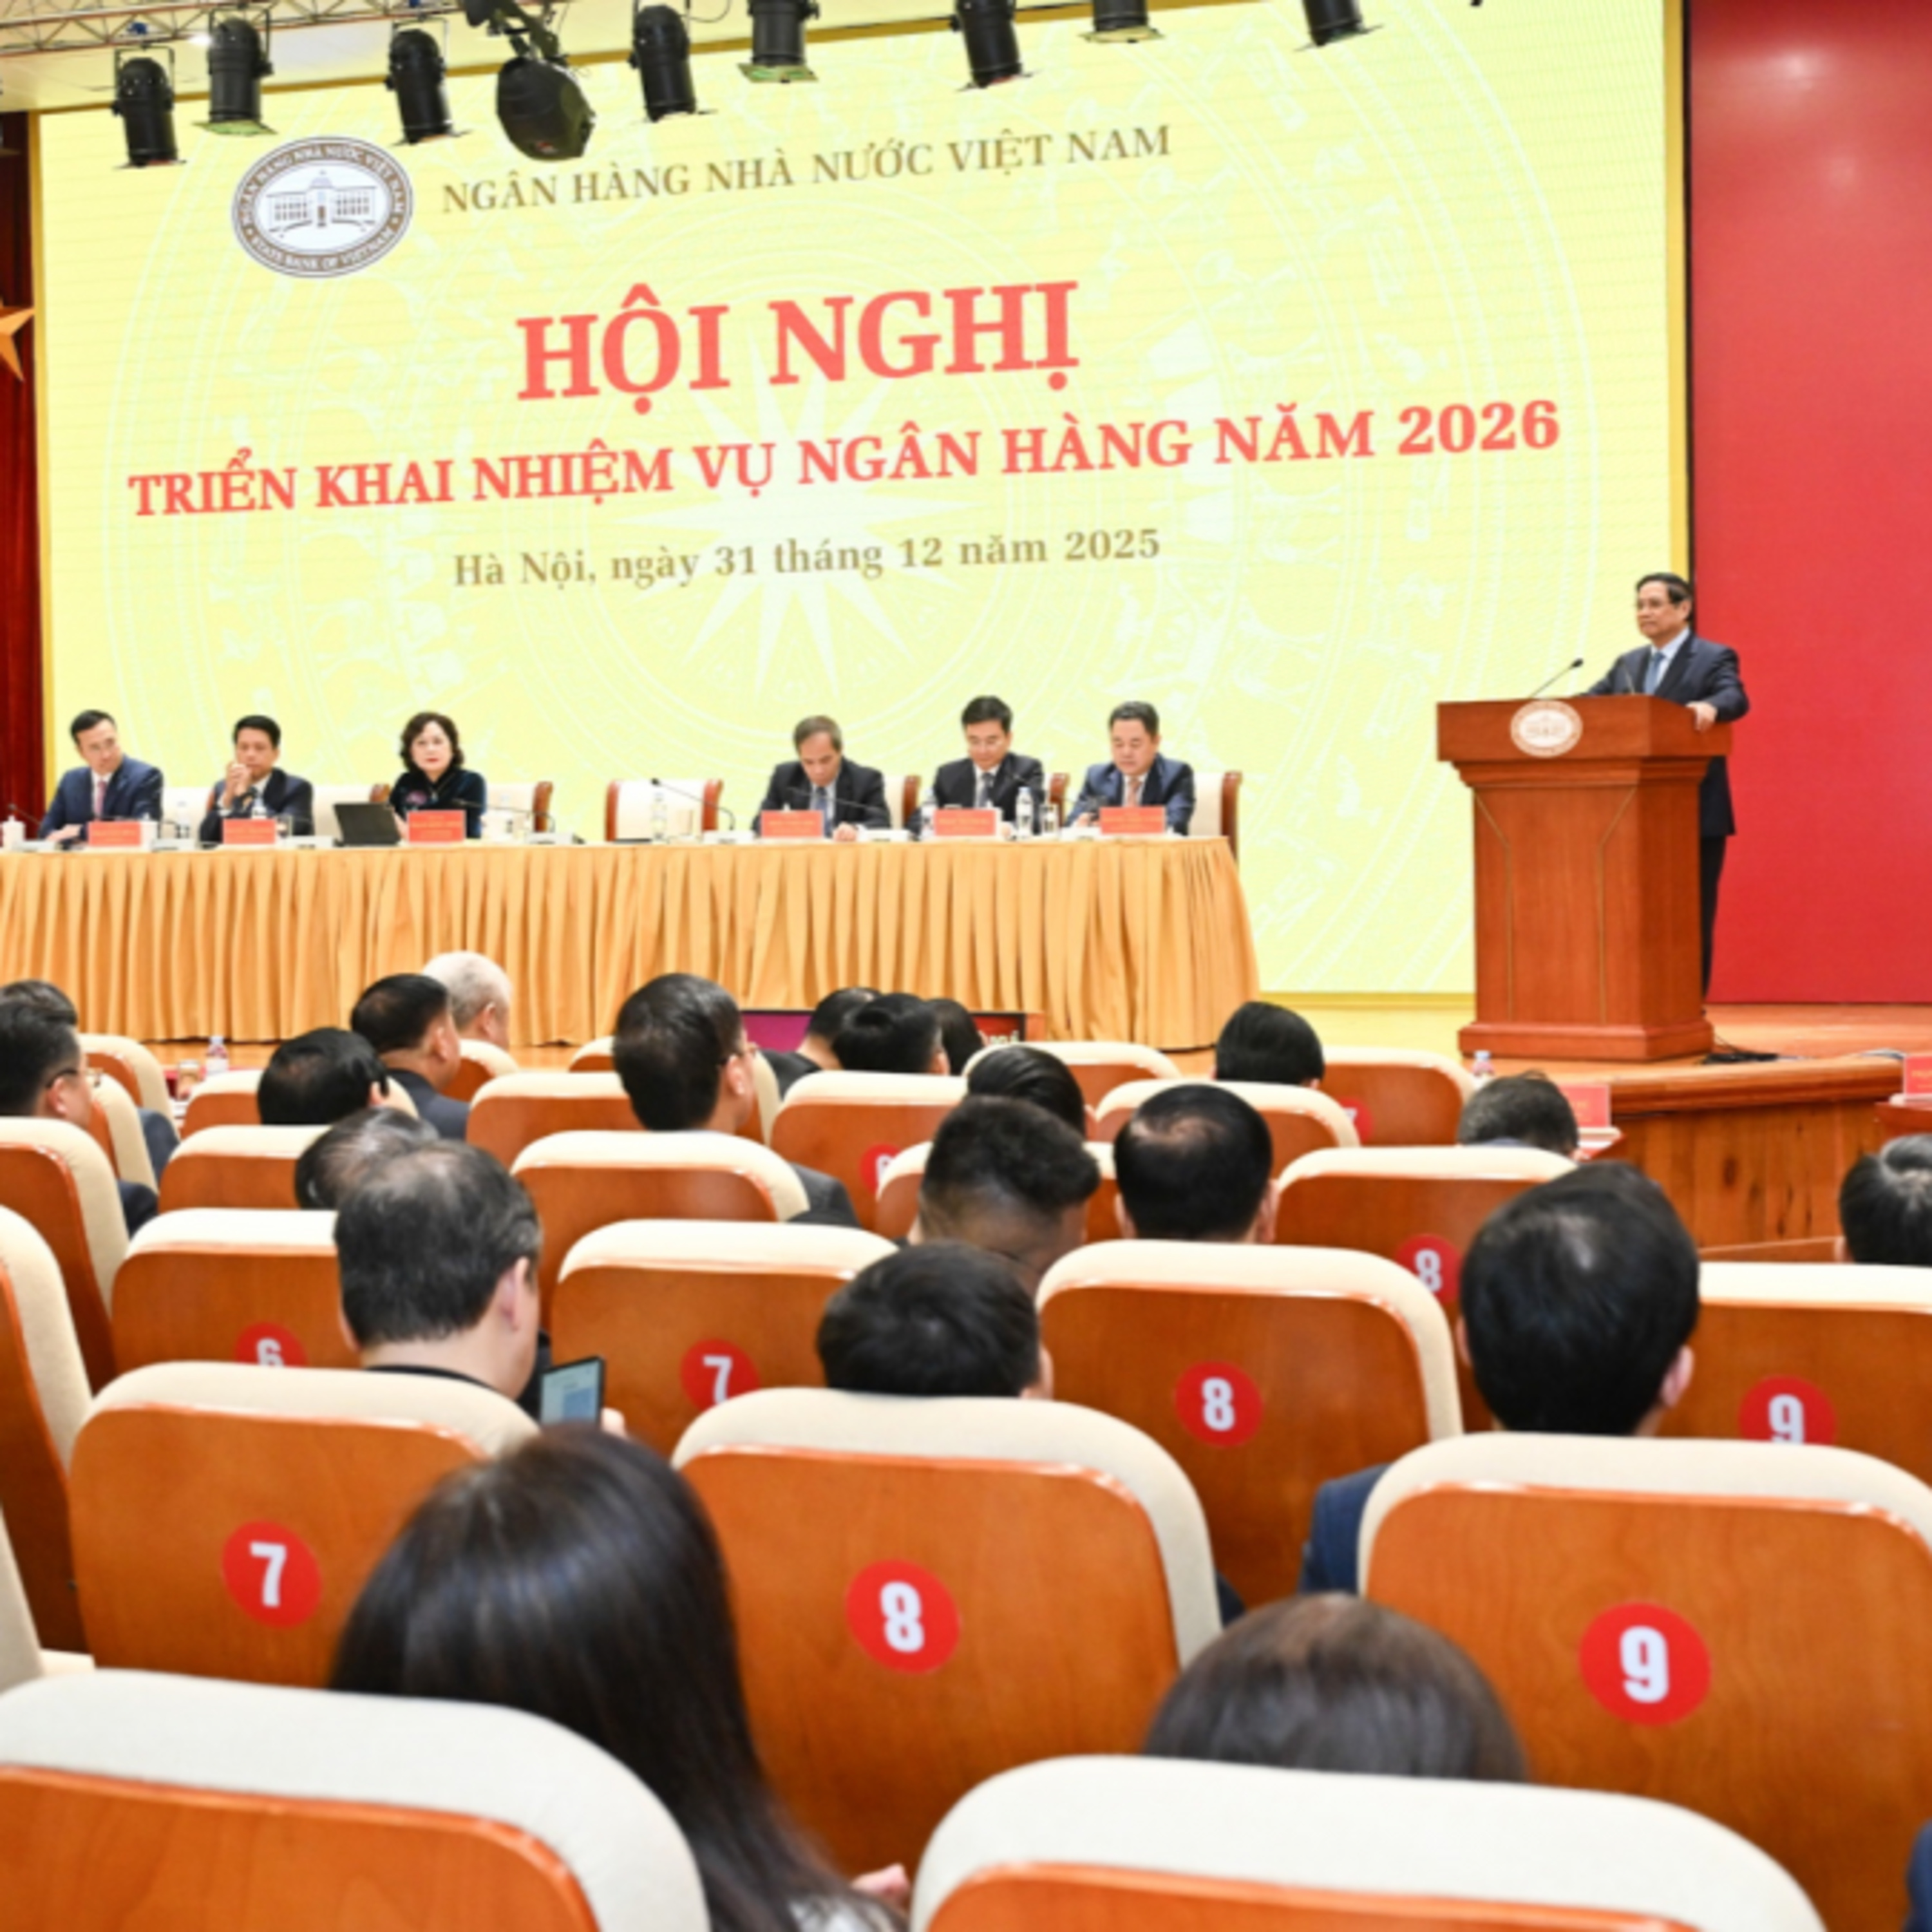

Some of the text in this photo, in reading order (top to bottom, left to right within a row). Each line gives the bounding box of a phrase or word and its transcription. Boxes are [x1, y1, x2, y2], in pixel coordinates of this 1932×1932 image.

[442, 124, 1170, 213] NGÂN HÀNG NHÀ NƯỚC VIỆT NAM
[516, 281, 1079, 414] HỘI NGHỊ
[128, 400, 1558, 516] TRIỂN KHAI NHIỆM VỤ NGÂN HÀNG NĂM 2026
[453, 527, 1161, 591] Hà Nội, ngày 31 tháng 12 năm 2025
[1415, 1248, 1443, 1293] 8
[703, 1355, 733, 1404] 7
[1202, 1378, 1235, 1432] 8
[1768, 1394, 1805, 1444] 9
[249, 1540, 287, 1607] 7
[879, 1580, 925, 1653] 8
[1619, 1625, 1670, 1703] 9
